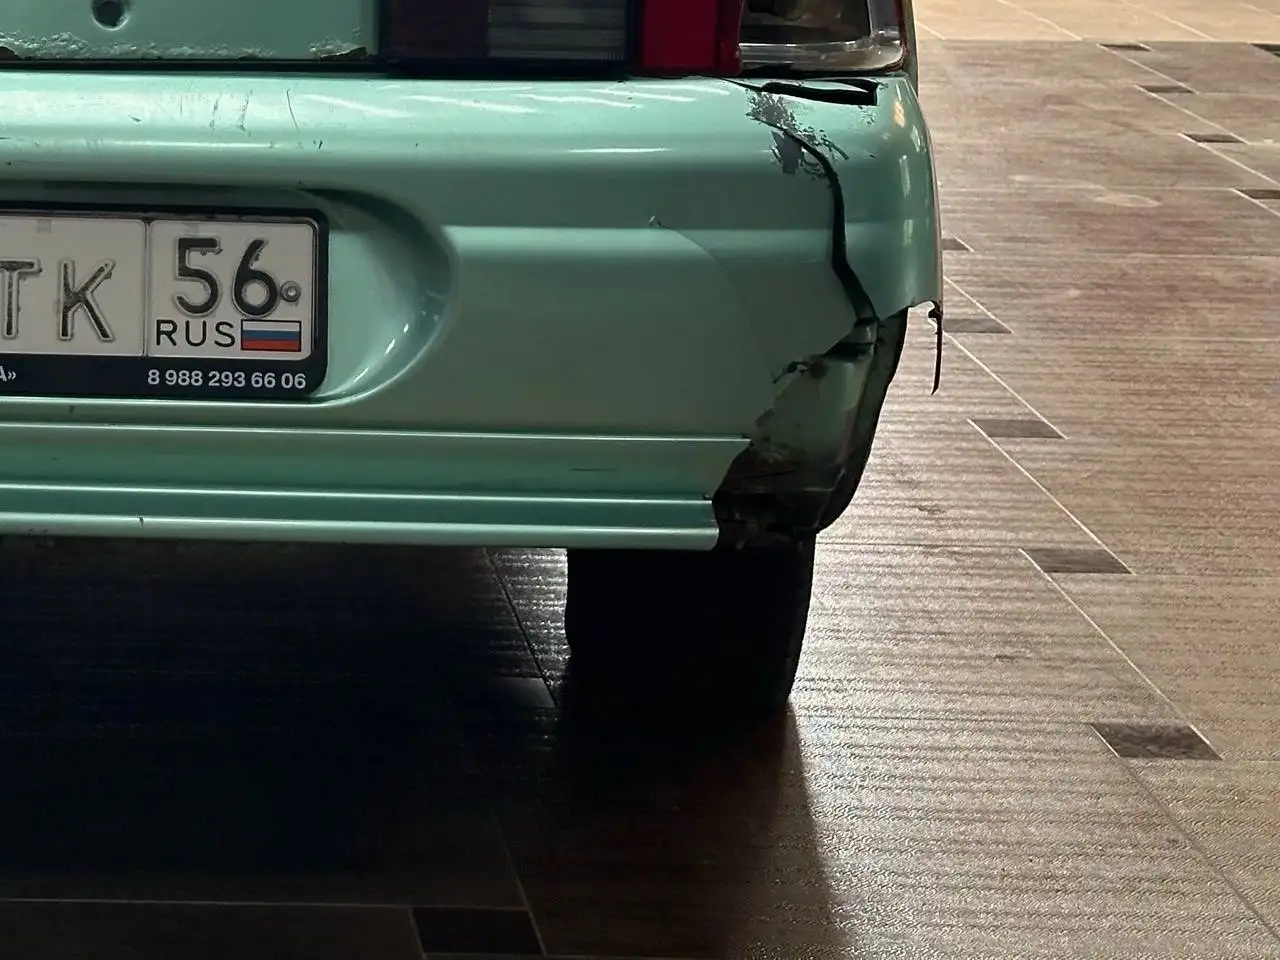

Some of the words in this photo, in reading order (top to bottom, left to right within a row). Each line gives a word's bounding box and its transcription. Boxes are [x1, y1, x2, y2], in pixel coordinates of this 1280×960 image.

[176, 236, 280, 318] 56
[155, 318, 237, 348] RUS
[147, 369, 160, 386] 8
[164, 370, 204, 387] 988
[207, 370, 247, 388] 293
[250, 371, 276, 389] 66
[280, 372, 307, 390] 06
